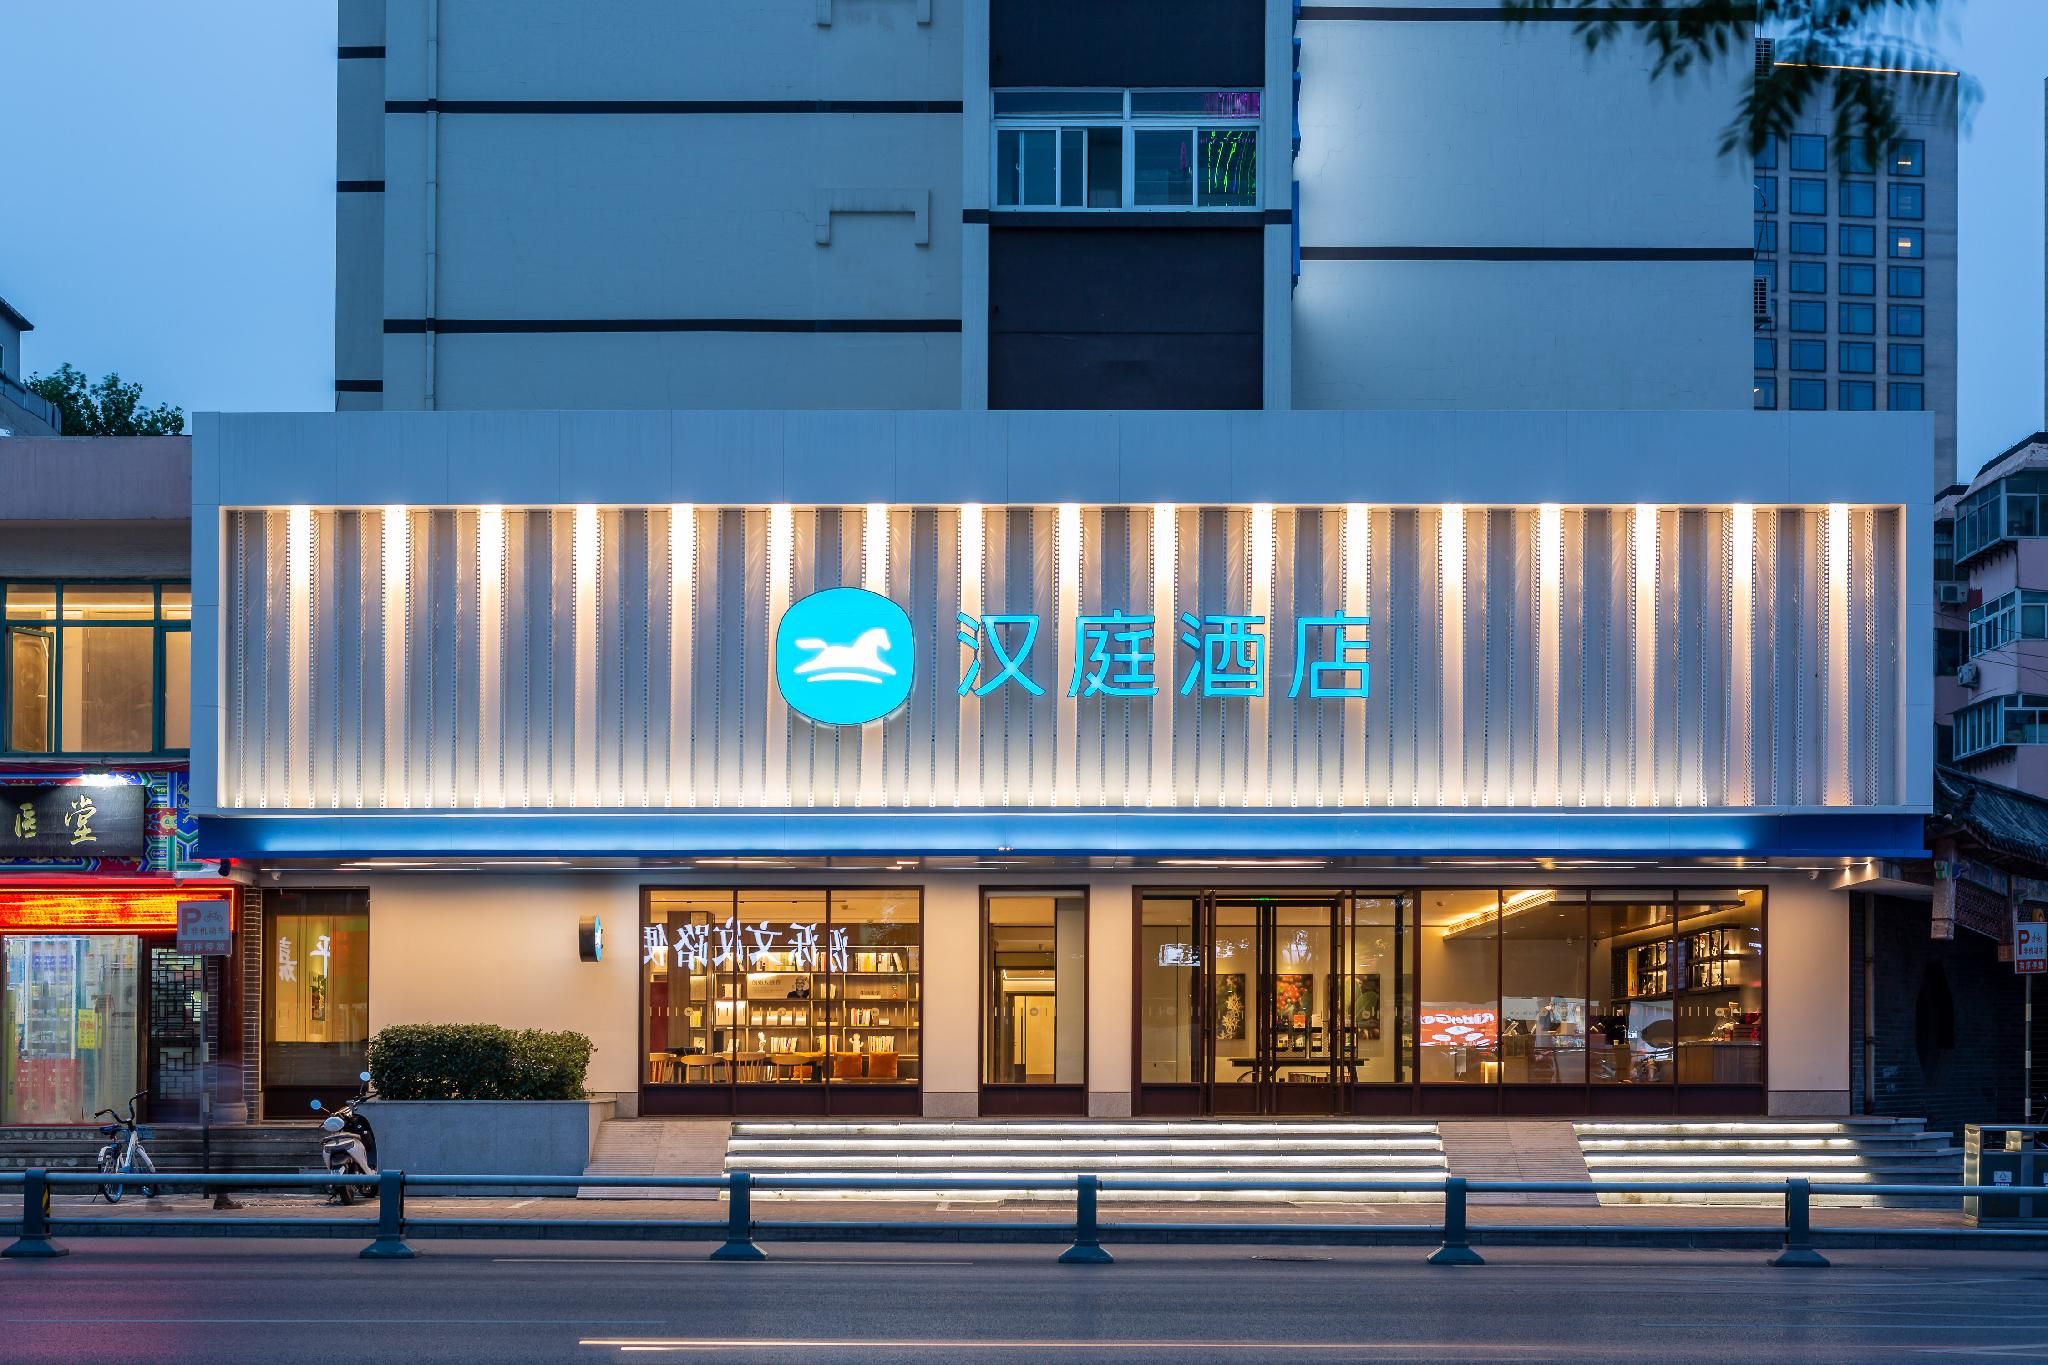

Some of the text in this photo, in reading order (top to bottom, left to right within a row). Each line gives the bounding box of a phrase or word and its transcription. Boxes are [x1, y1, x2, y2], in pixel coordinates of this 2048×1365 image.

[956, 609, 1371, 699] 汉庭酒店
[182, 908, 201, 935] P
[191, 927, 226, 936] 非机动车
[2018, 930, 2030, 955] P
